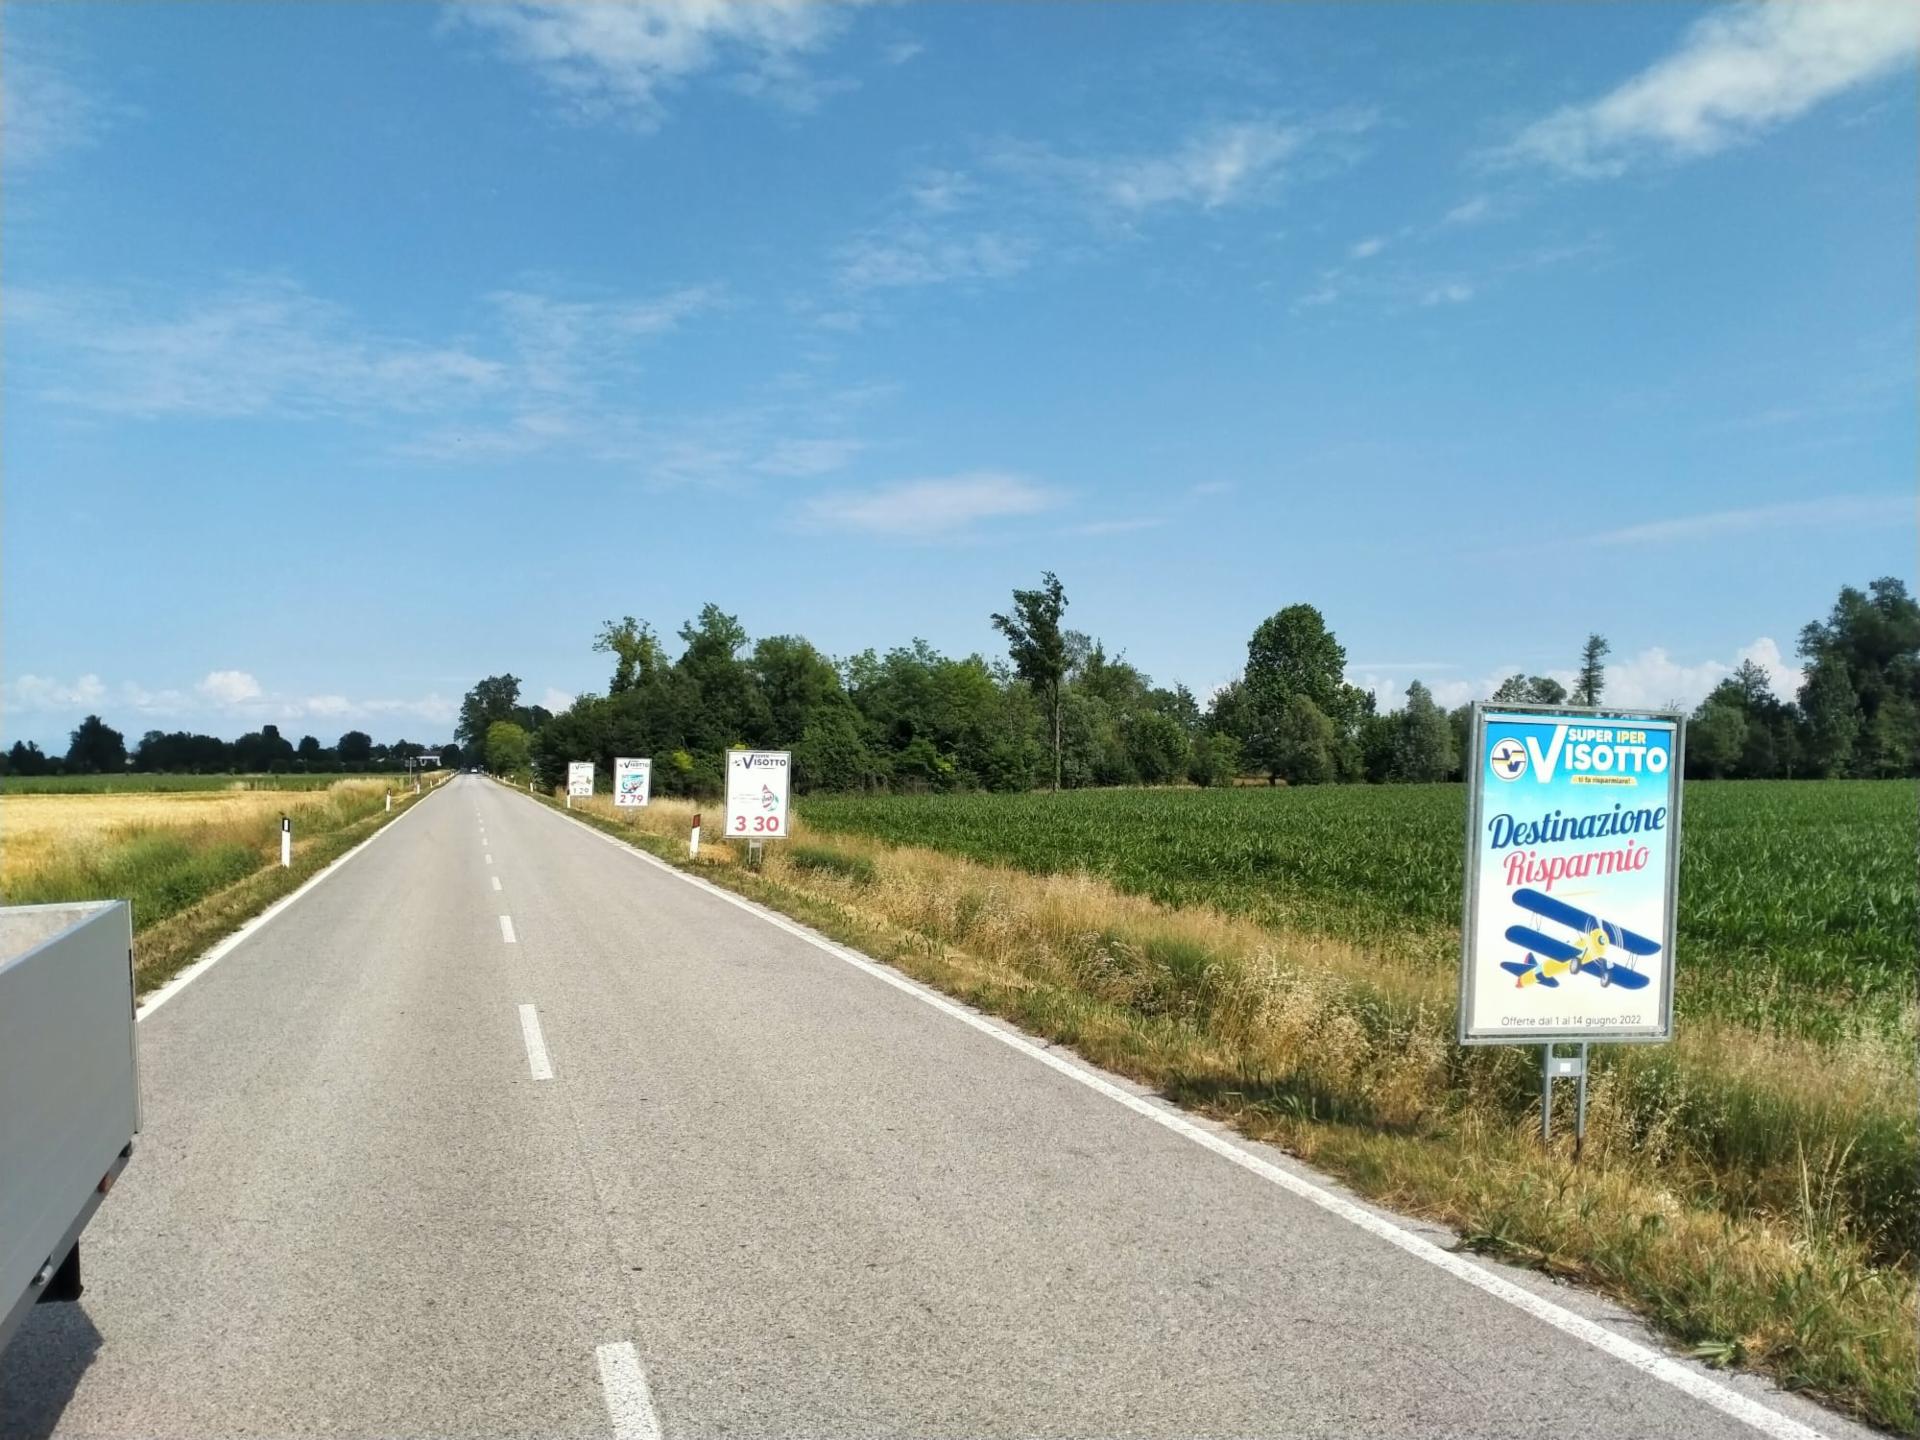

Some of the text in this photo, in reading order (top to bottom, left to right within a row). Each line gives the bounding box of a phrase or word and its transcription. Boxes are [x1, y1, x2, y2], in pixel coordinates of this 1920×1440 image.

[1568, 728, 1646, 744] SUPER IPER
[742, 754, 787, 769] VISOTTO
[1525, 725, 1668, 784] VISOTTO
[735, 815, 780, 832] 3 30
[1488, 803, 1666, 849] Destinazione
[1503, 840, 1650, 892] Risparmio
[1501, 1016, 1536, 1026] Offerte
[1538, 1016, 1553, 1026] dal
[1562, 1016, 1570, 1026] al
[1573, 1016, 1582, 1025] 14
[1585, 1015, 1618, 1027] giugno
[1620, 1015, 1641, 1025] 2022
